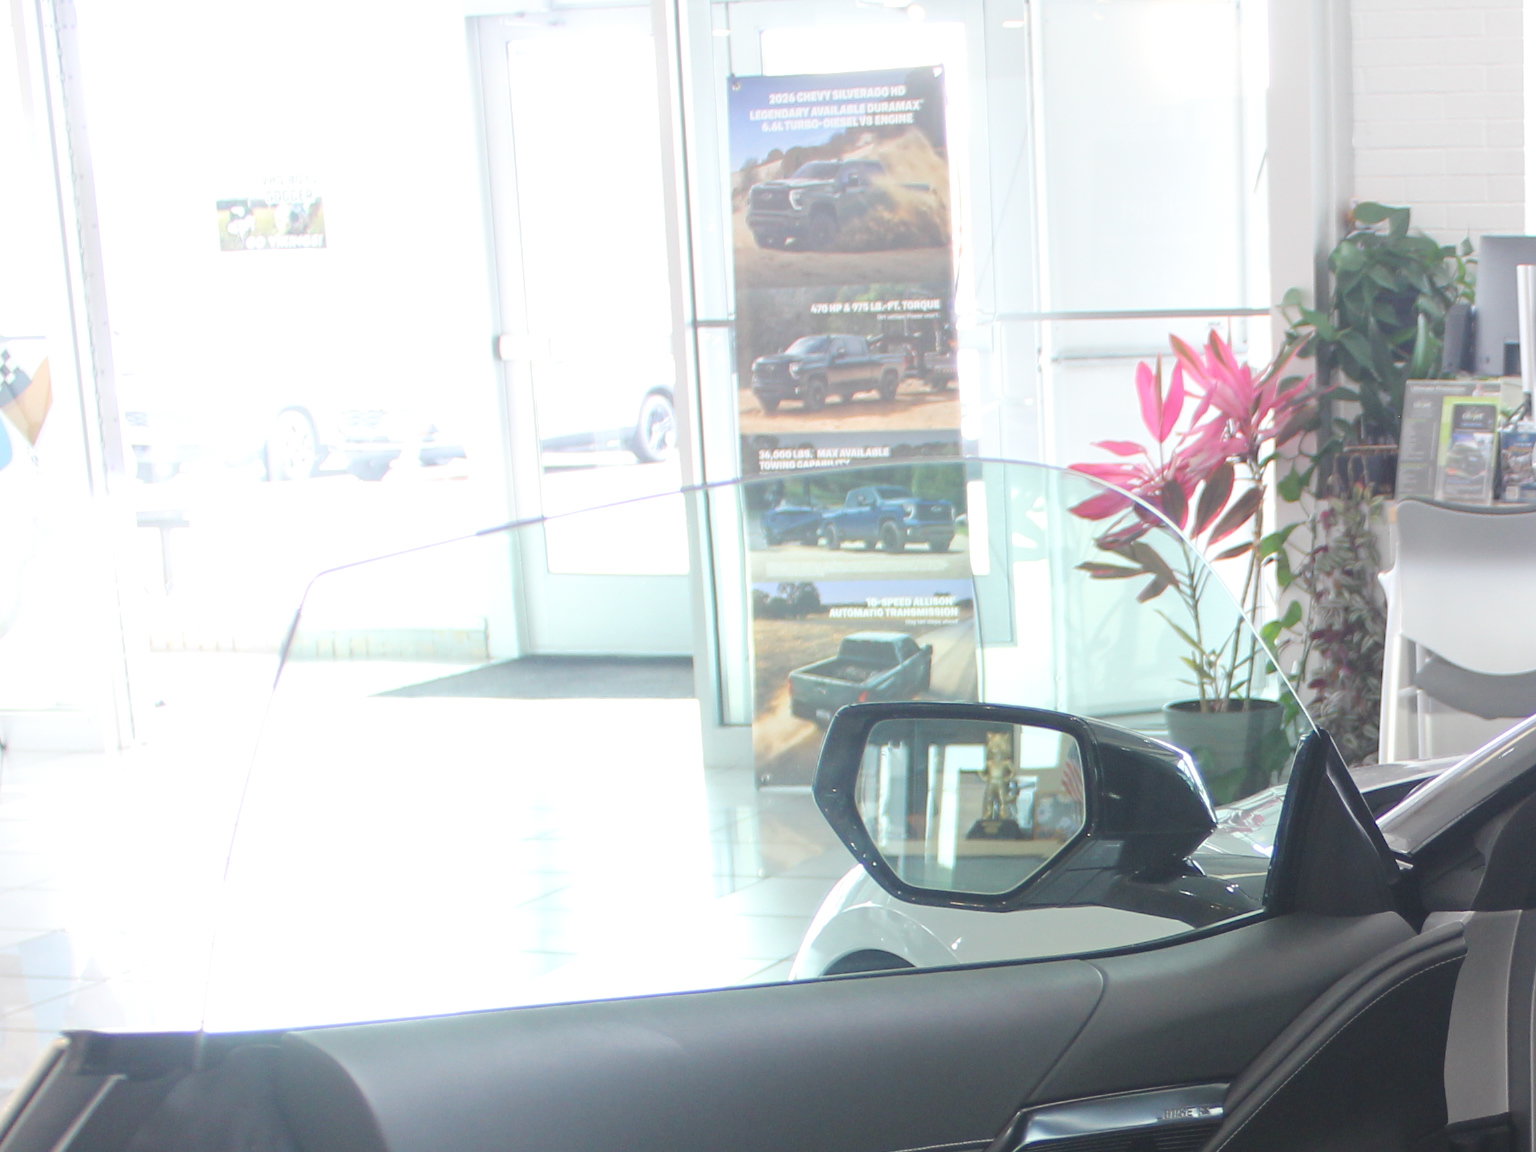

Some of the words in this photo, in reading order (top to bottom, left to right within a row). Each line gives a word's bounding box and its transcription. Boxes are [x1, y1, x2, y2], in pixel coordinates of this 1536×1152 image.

[797, 90, 831, 103] CHEVY
[832, 87, 889, 101] SILVERADO
[890, 85, 907, 97] HD
[749, 107, 809, 121] LEGENDARY
[810, 103, 866, 117] AVAILABLE
[874, 113, 914, 125] ENGINE
[902, 299, 940, 311] TORQUE
[817, 447, 839, 458] MAX
[839, 446, 890, 458] AVAILABLE
[759, 460, 796, 471] TOWING
[829, 607, 883, 618] AUTOMATIC
[884, 607, 959, 617] TRANSMISSION
